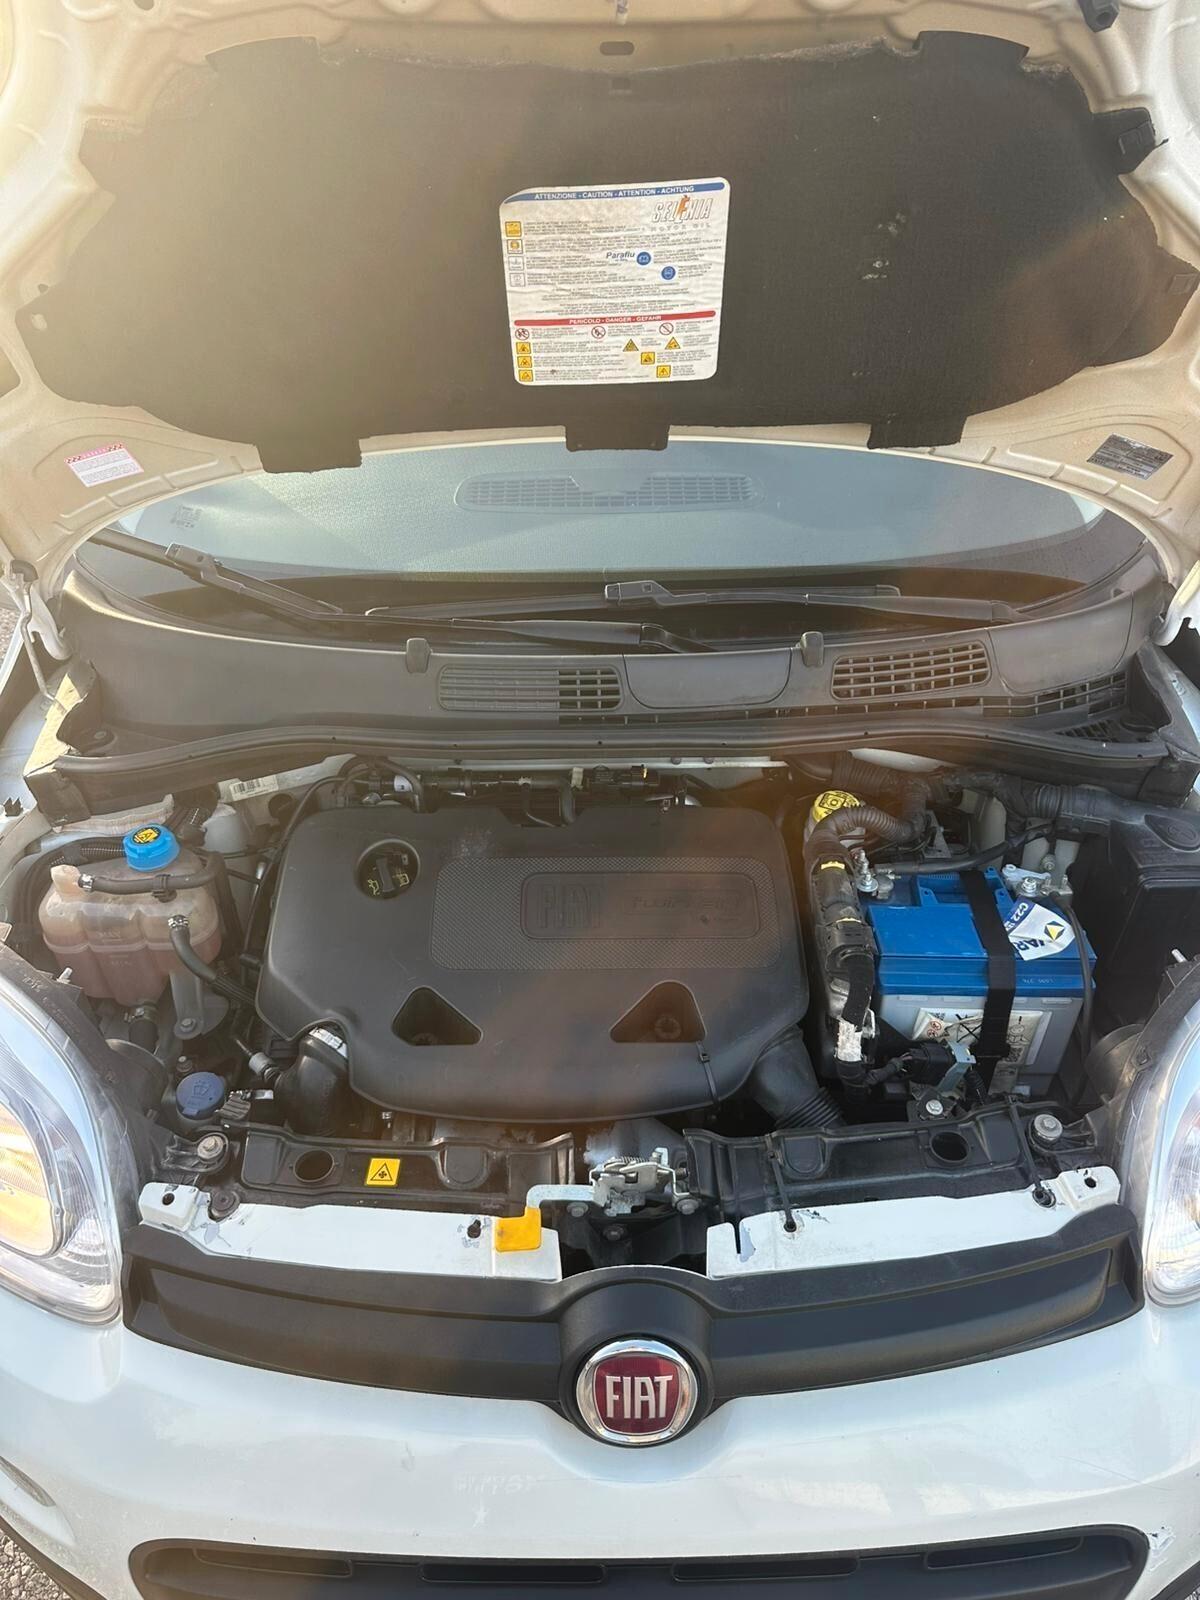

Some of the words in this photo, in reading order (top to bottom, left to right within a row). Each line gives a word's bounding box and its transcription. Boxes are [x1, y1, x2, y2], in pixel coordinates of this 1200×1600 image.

[534, 192, 577, 200] ATTENZIONE
[660, 186, 695, 194] ACHTUNG
[1010, 902, 1029, 922] C22
[605, 1374, 674, 1420] FIAT
